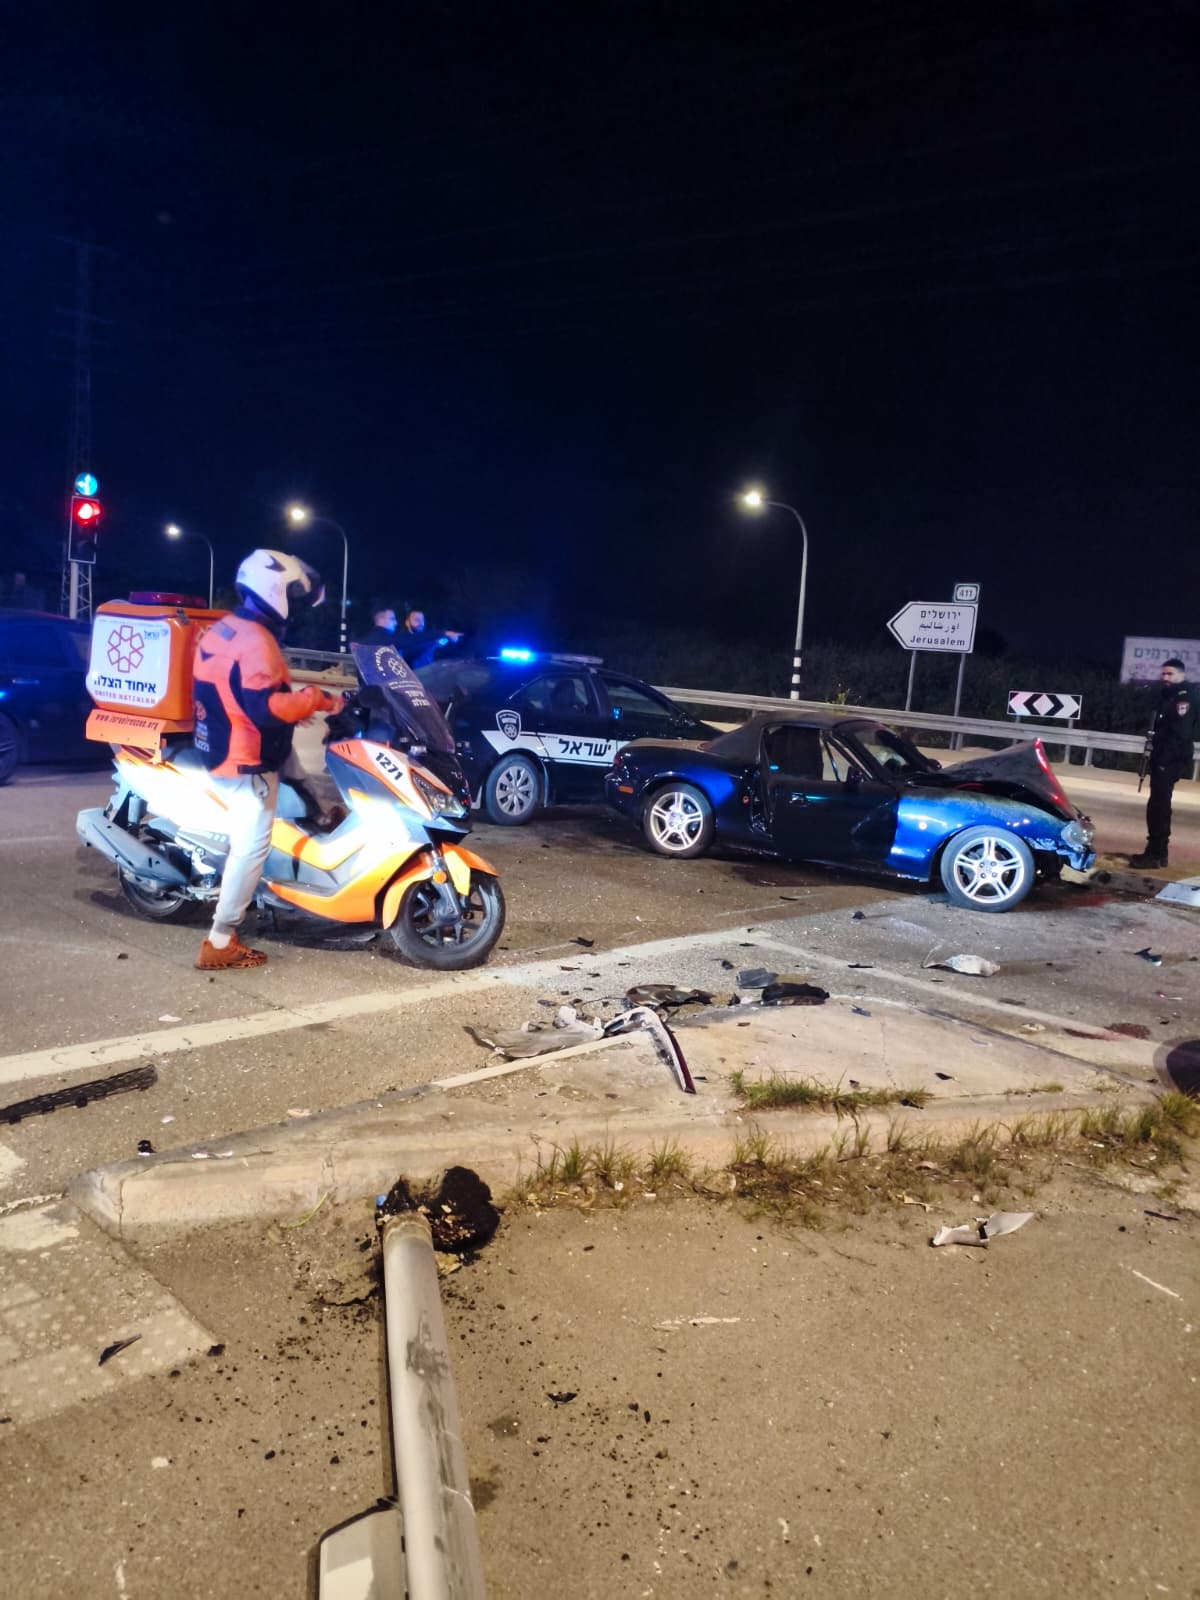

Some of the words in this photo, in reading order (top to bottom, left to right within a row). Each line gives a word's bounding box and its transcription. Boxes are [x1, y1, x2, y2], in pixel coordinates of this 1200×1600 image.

[959, 589, 973, 597] 411
[920, 609, 961, 619] ירושלים
[910, 635, 965, 646] Jerusalem
[125, 680, 156, 693] איחוד
[558, 738, 612, 757] ישראל
[375, 752, 404, 780] 1271
